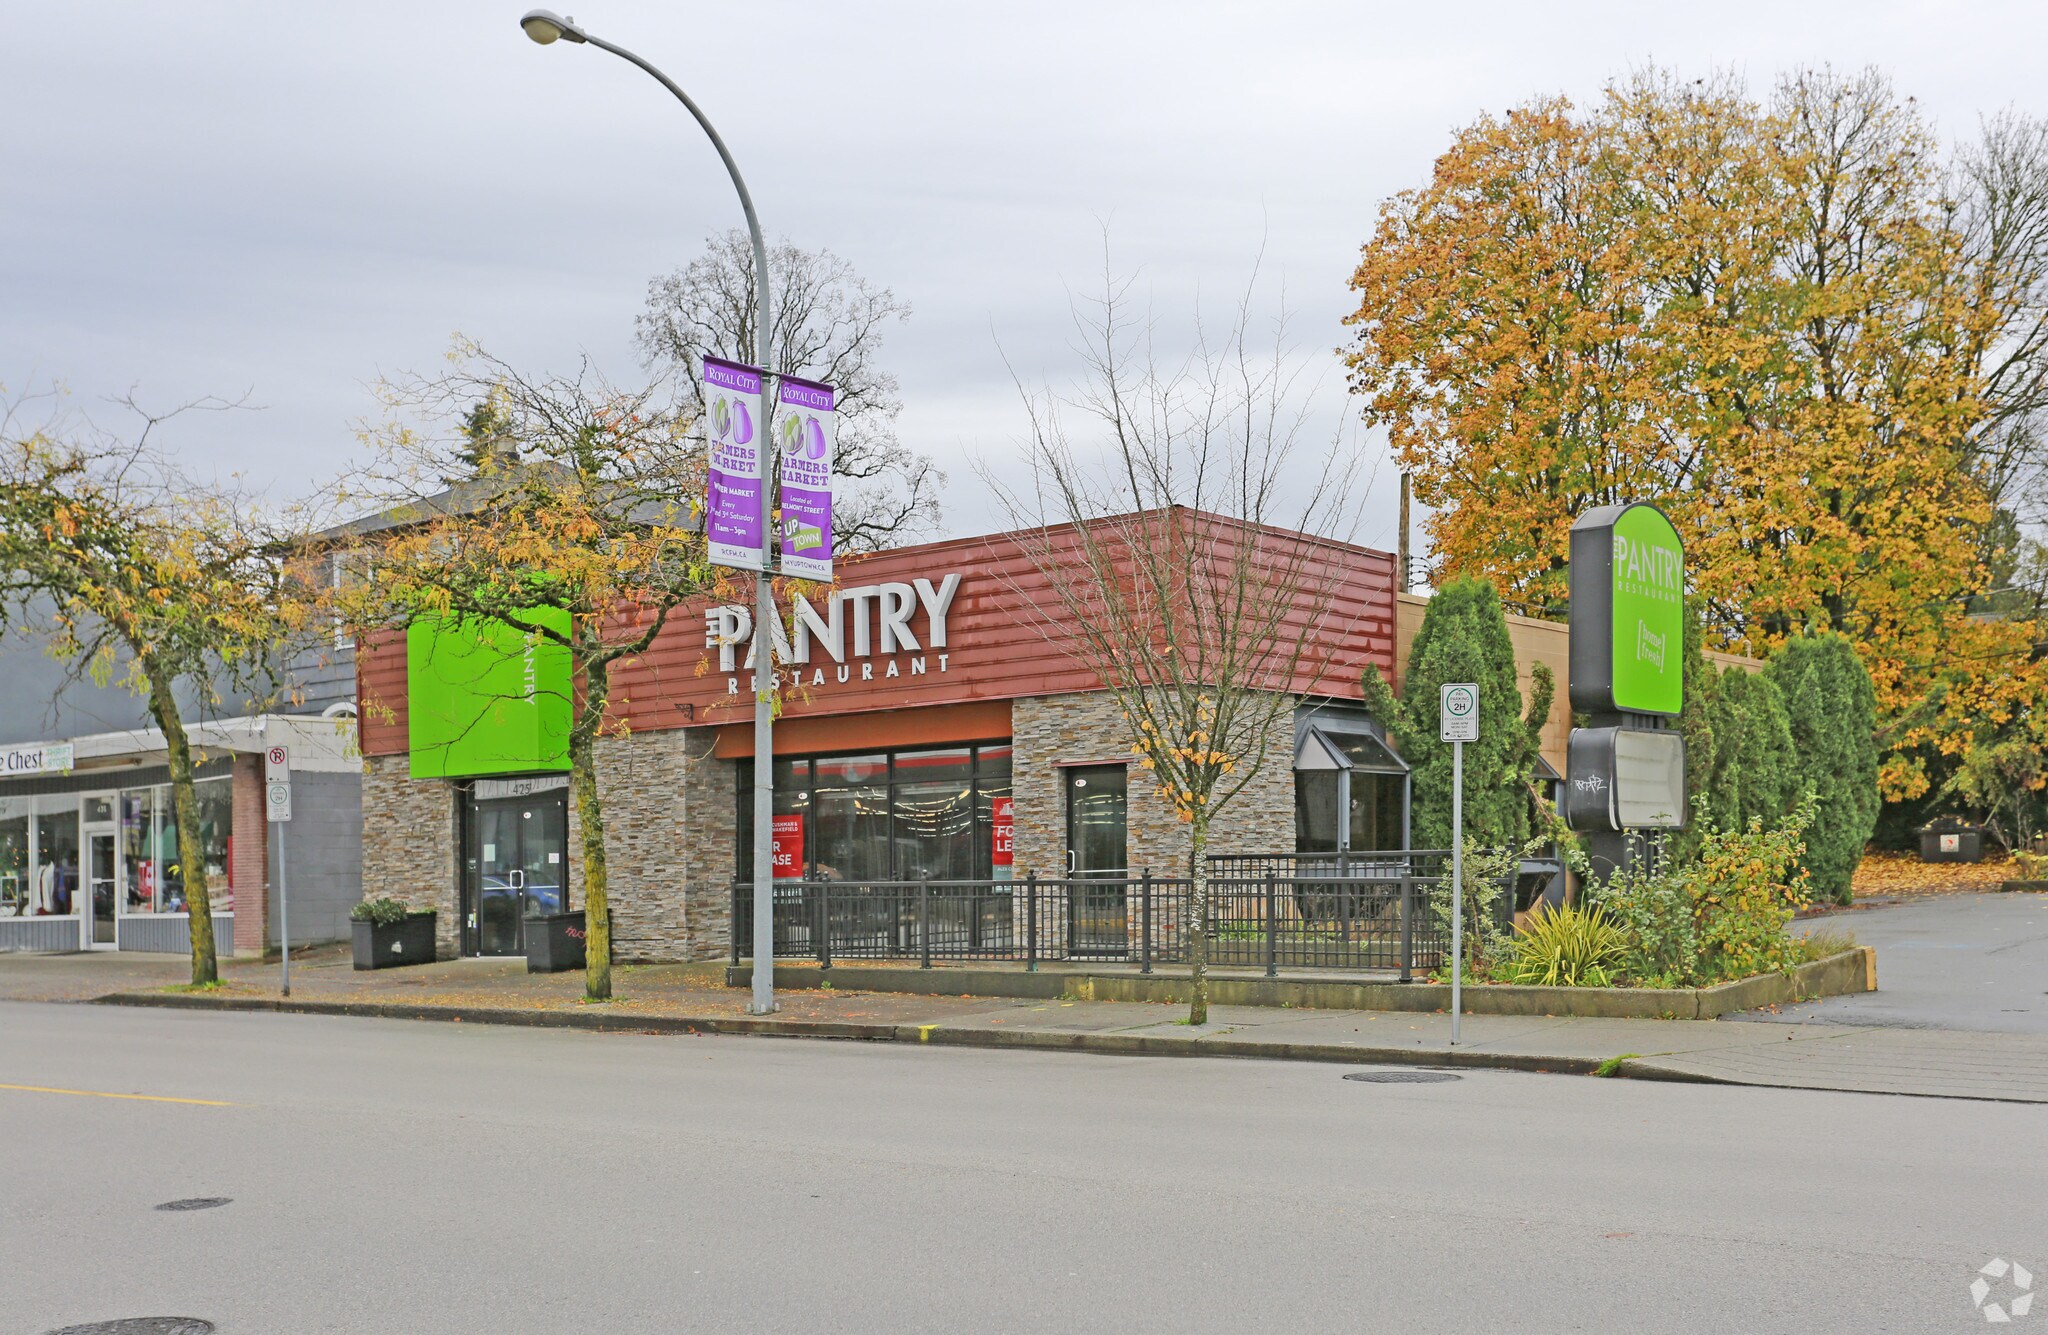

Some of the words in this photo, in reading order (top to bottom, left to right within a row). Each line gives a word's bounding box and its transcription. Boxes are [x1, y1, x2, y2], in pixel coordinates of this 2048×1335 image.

[708, 366, 735, 385] ROYAL
[737, 374, 757, 389] CITY
[783, 386, 809, 403] ROYAL
[810, 392, 830, 407] CITY
[711, 440, 755, 459] FRMERS
[714, 453, 755, 472] MRKET
[729, 487, 755, 498] MARKET
[790, 495, 806, 504] Located
[722, 500, 735, 509] Every
[804, 506, 825, 514] STREET
[729, 512, 754, 523] Saturday
[784, 518, 798, 537] UP
[795, 532, 820, 548] TOWN
[784, 559, 825, 571] MYUPTOWN.CA
[1618, 535, 1684, 592] PANTRY
[1618, 580, 1681, 605] RESTAURANT
[719, 573, 962, 672] PANTRY
[1454, 702, 1466, 711] 2H
[8, 750, 43, 770] Chest
[513, 783, 530, 794] 425
